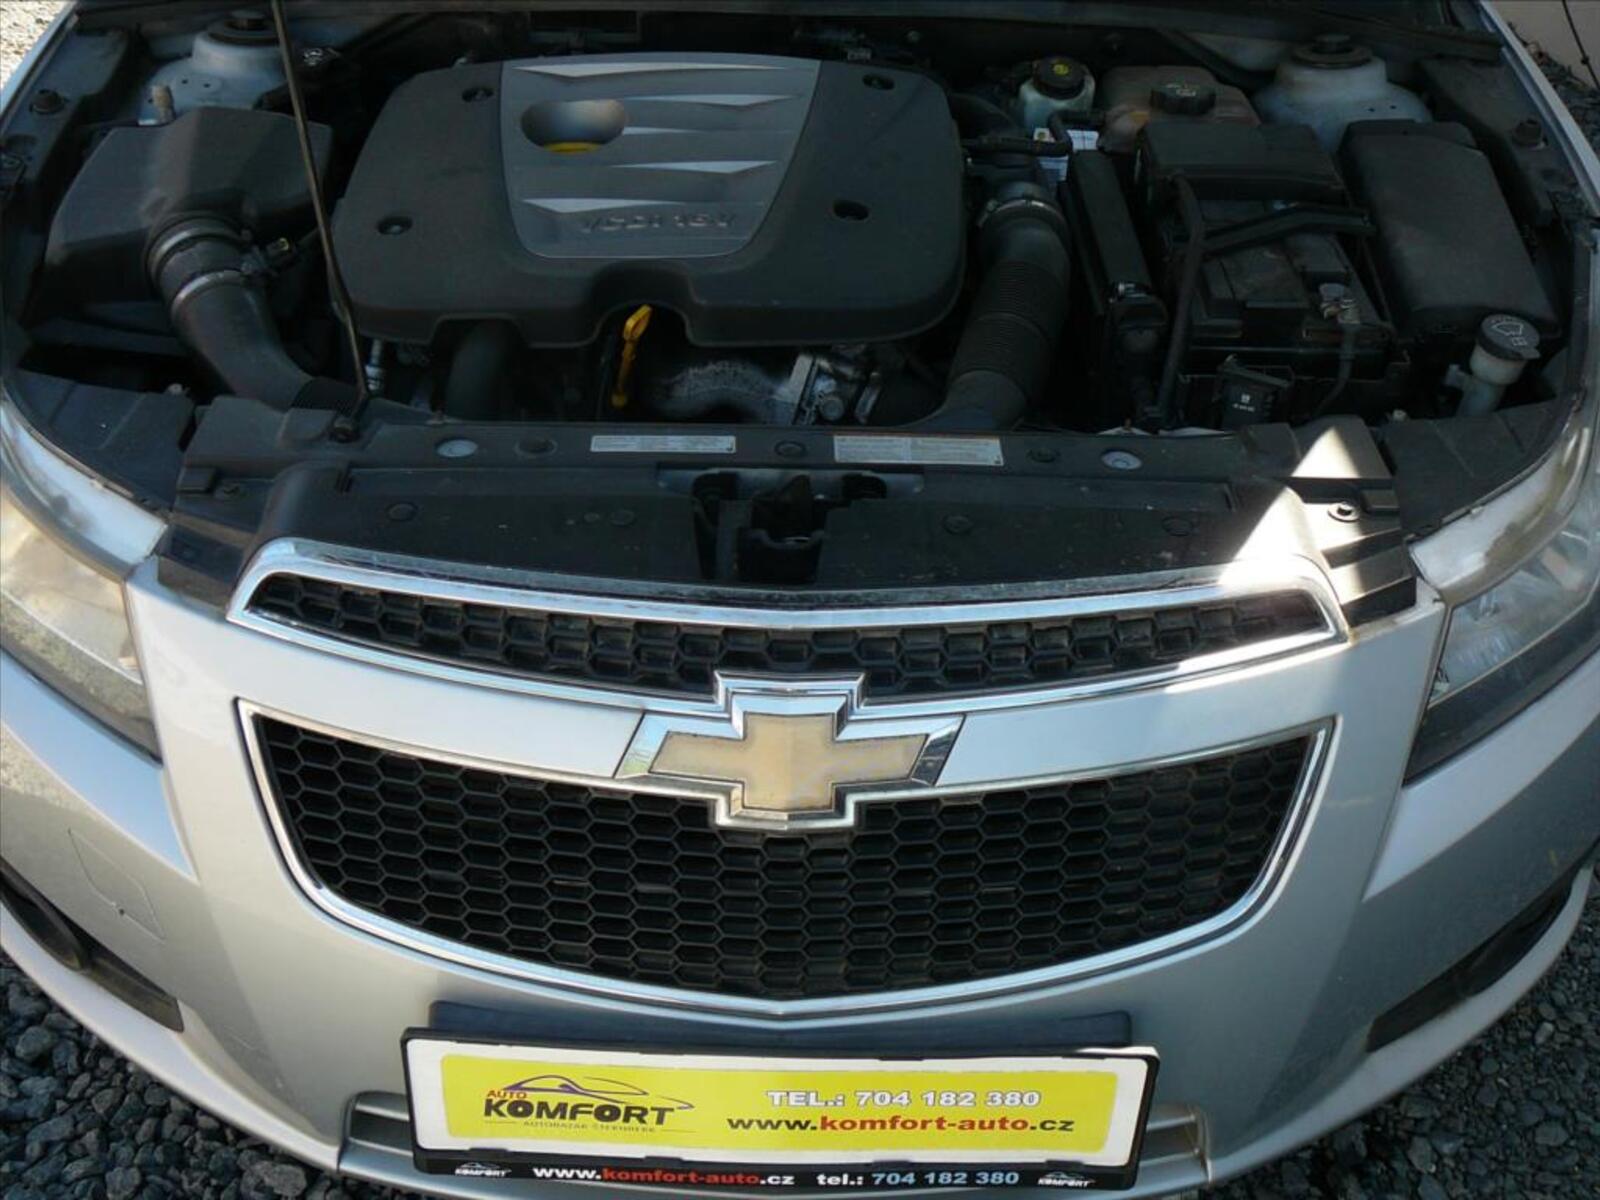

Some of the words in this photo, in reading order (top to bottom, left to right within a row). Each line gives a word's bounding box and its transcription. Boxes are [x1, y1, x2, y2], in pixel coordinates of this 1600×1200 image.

[487, 1090, 527, 1099] AUTO
[766, 1091, 845, 1107] TEL.:
[855, 1091, 911, 1106] 704
[921, 1091, 976, 1107] 182
[985, 1091, 1041, 1107] 380
[484, 1099, 674, 1125] KOMFORT
[727, 1114, 1075, 1132] www.komfort-auto.cz
[533, 1167, 795, 1186] www.komfort-auto.cz
[816, 1172, 863, 1186] tel.:
[872, 1172, 915, 1185] 704
[924, 1171, 968, 1185] 182
[975, 1171, 1020, 1185] 380
